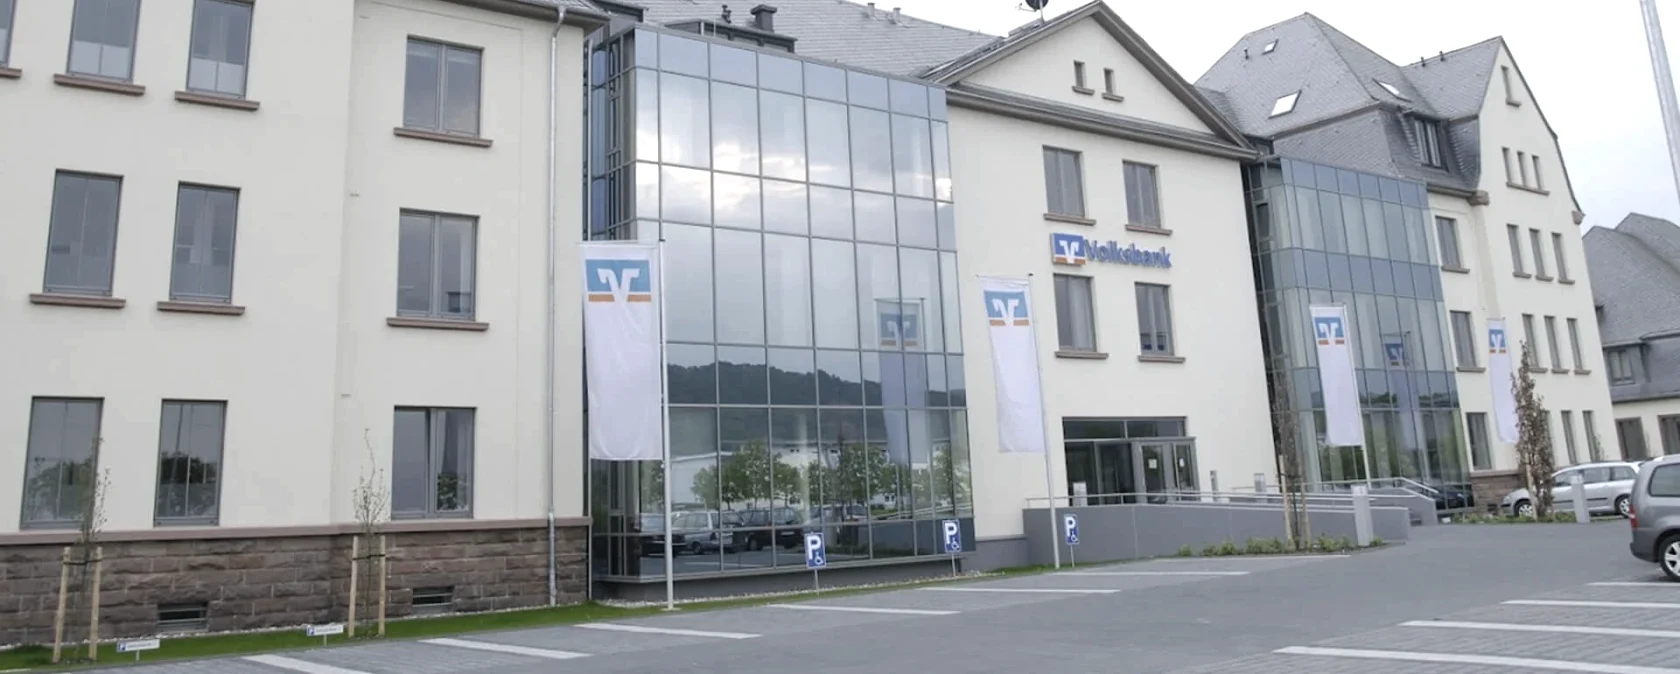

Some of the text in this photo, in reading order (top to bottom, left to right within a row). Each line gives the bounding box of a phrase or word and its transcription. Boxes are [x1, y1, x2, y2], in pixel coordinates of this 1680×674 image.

[1085, 240, 1172, 268] Volksbank
[944, 522, 957, 544] P
[1066, 516, 1076, 536] P
[807, 536, 820, 559] P
